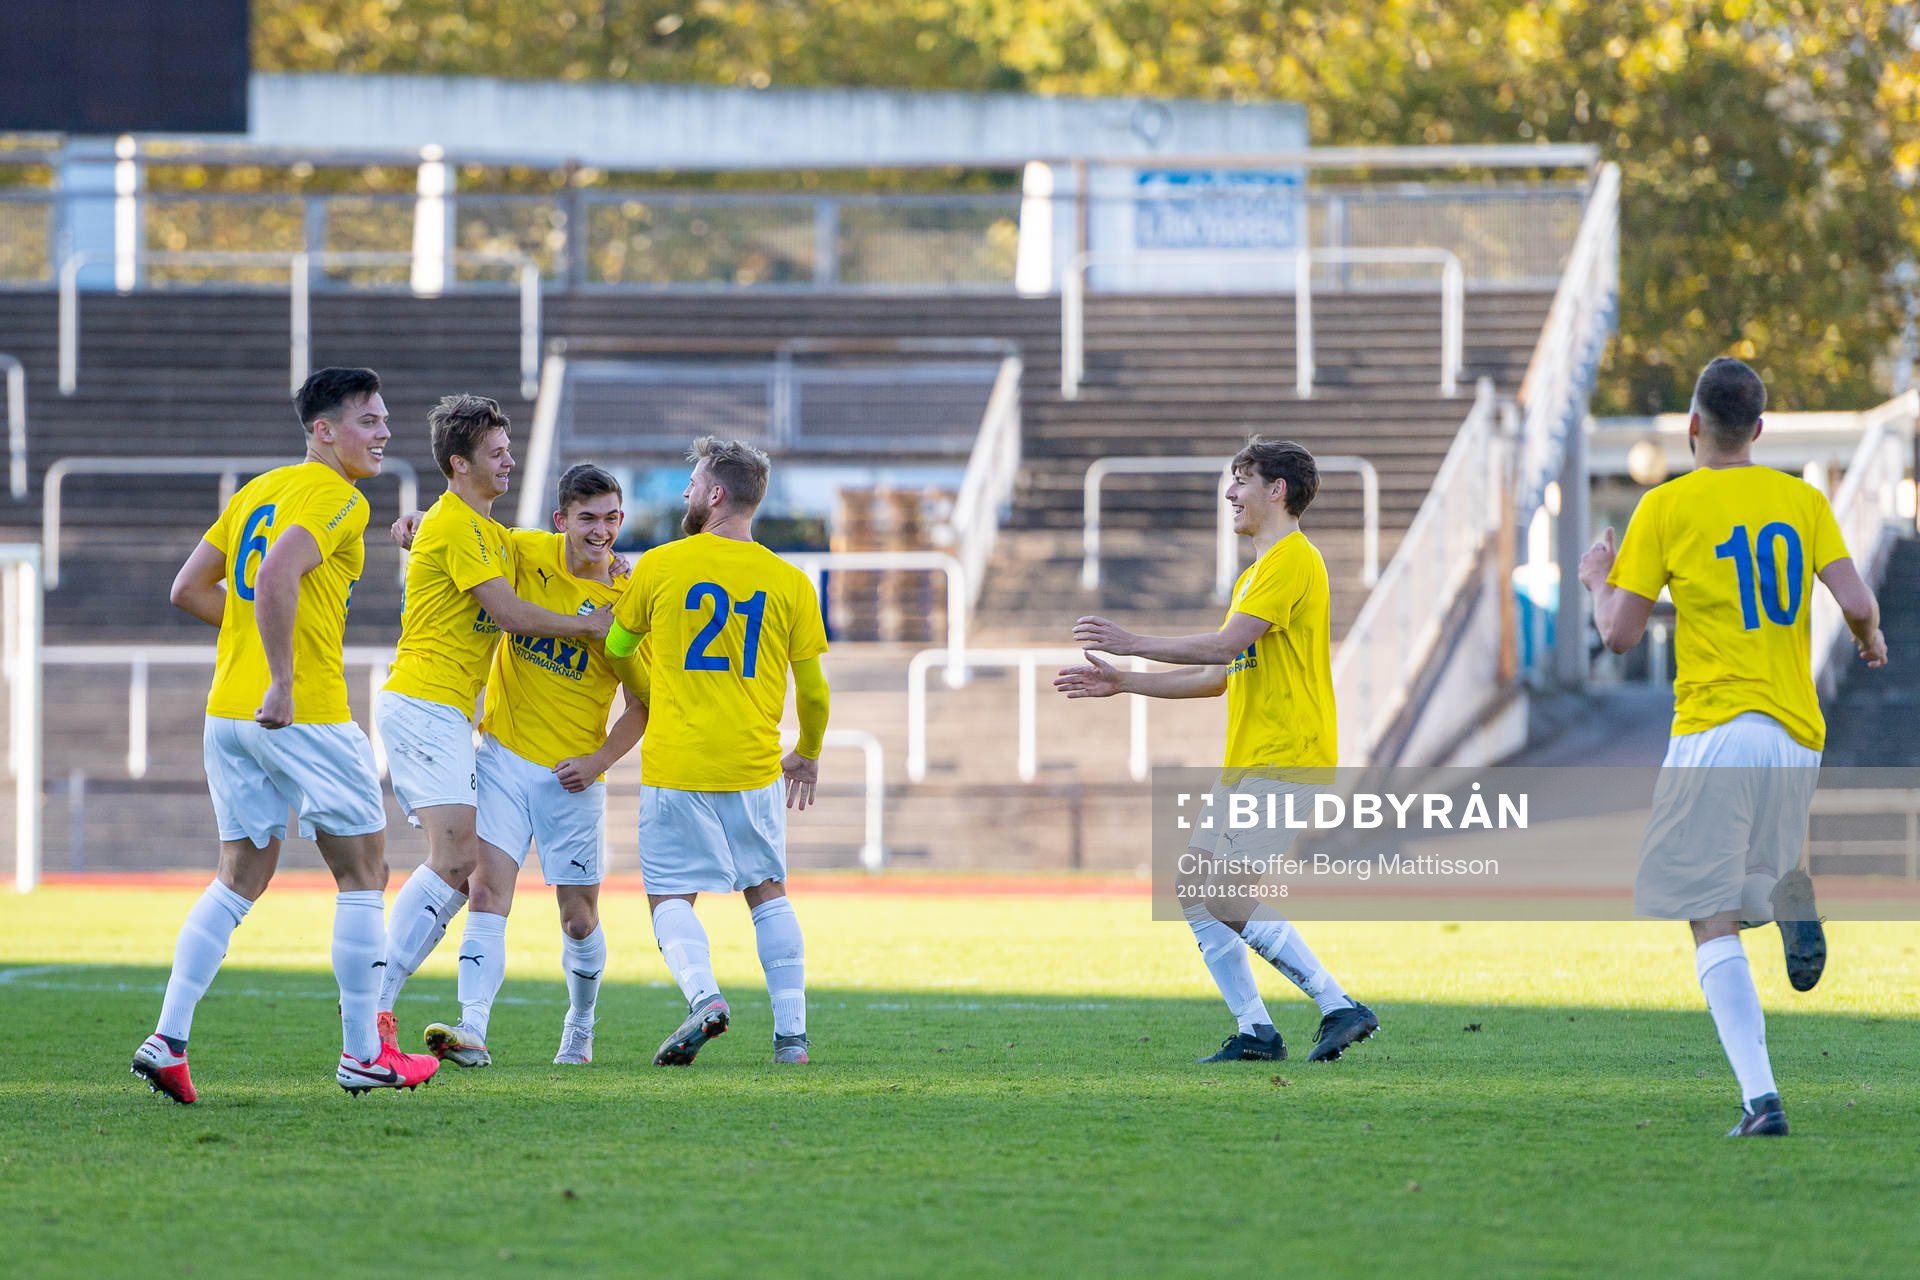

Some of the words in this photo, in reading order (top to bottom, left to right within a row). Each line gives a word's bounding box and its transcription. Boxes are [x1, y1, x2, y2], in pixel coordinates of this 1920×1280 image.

[234, 503, 277, 602] 6
[1714, 520, 1804, 631] 10
[515, 645, 583, 681] STORMARKNAD
[684, 581, 767, 679] 21
[470, 772, 477, 791] 8
